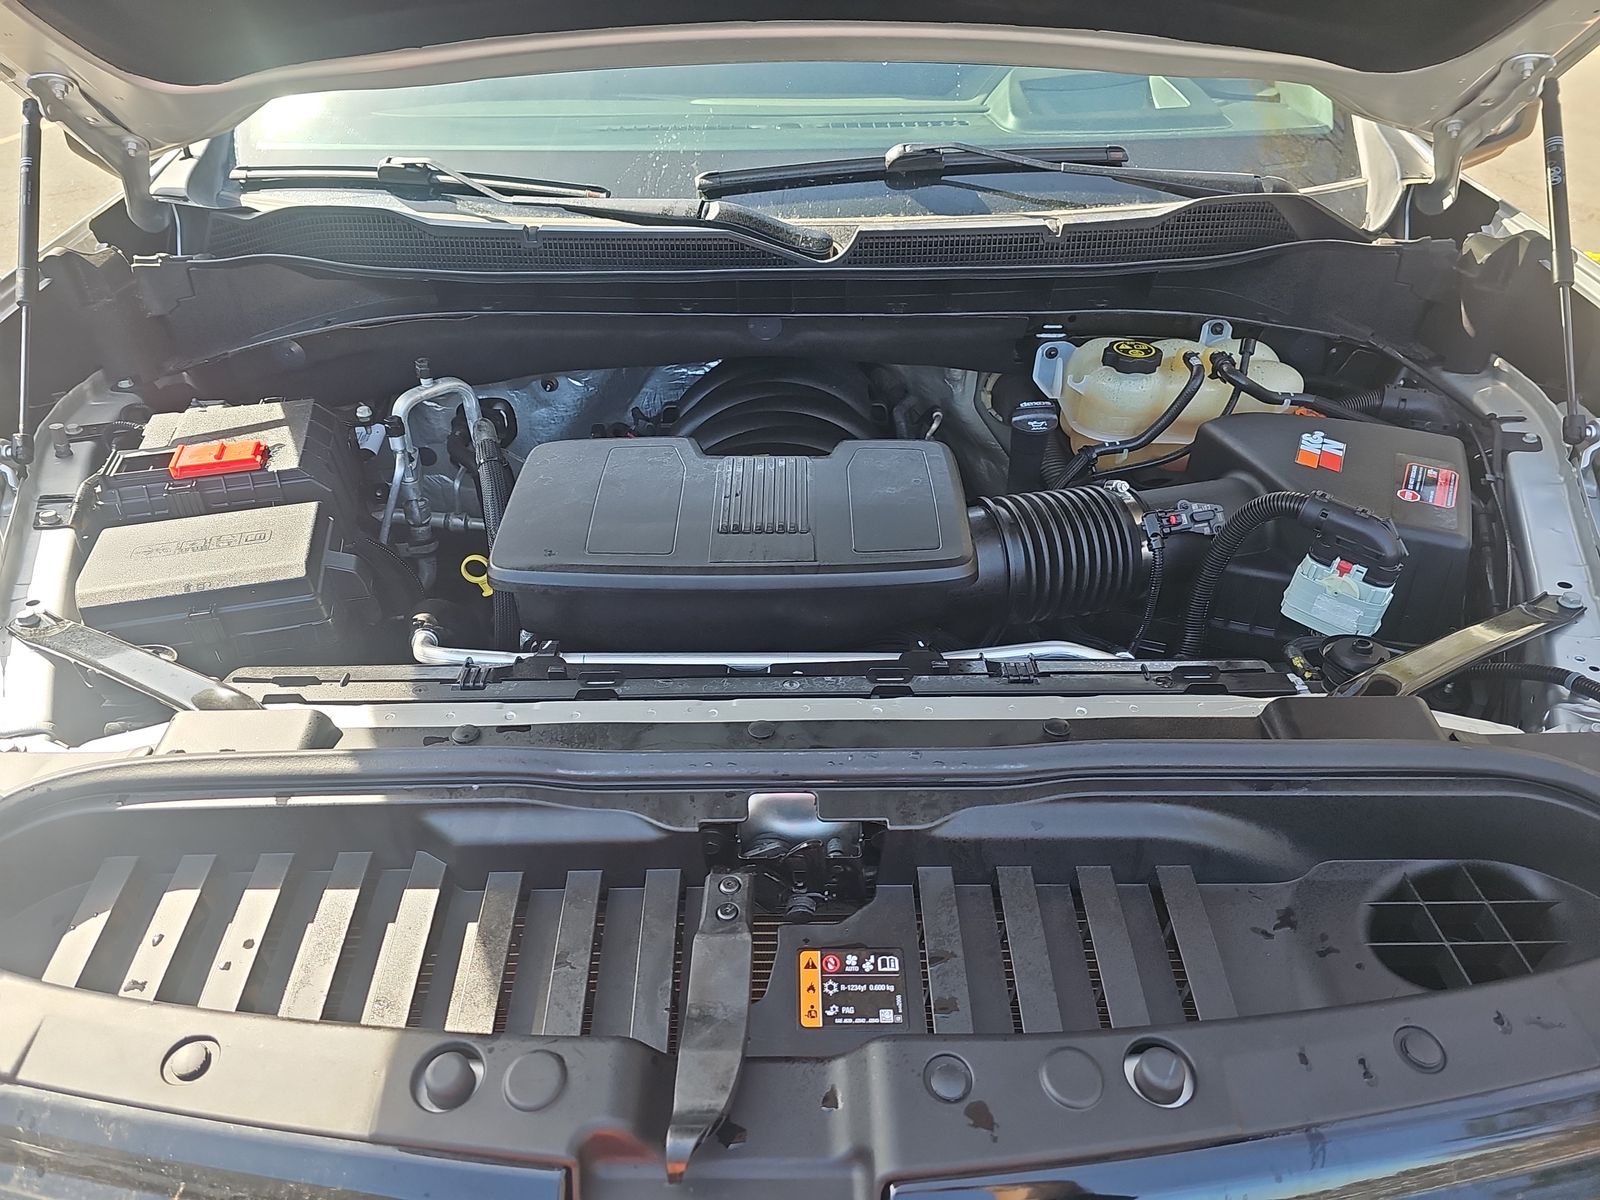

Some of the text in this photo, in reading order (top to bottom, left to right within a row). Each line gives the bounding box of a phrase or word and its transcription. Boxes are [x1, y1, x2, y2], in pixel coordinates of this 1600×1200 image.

[1300, 430, 1346, 456] K&N
[840, 984, 867, 992] R-1234yf
[886, 984, 895, 992] kg
[841, 1006, 855, 1014] PAG
